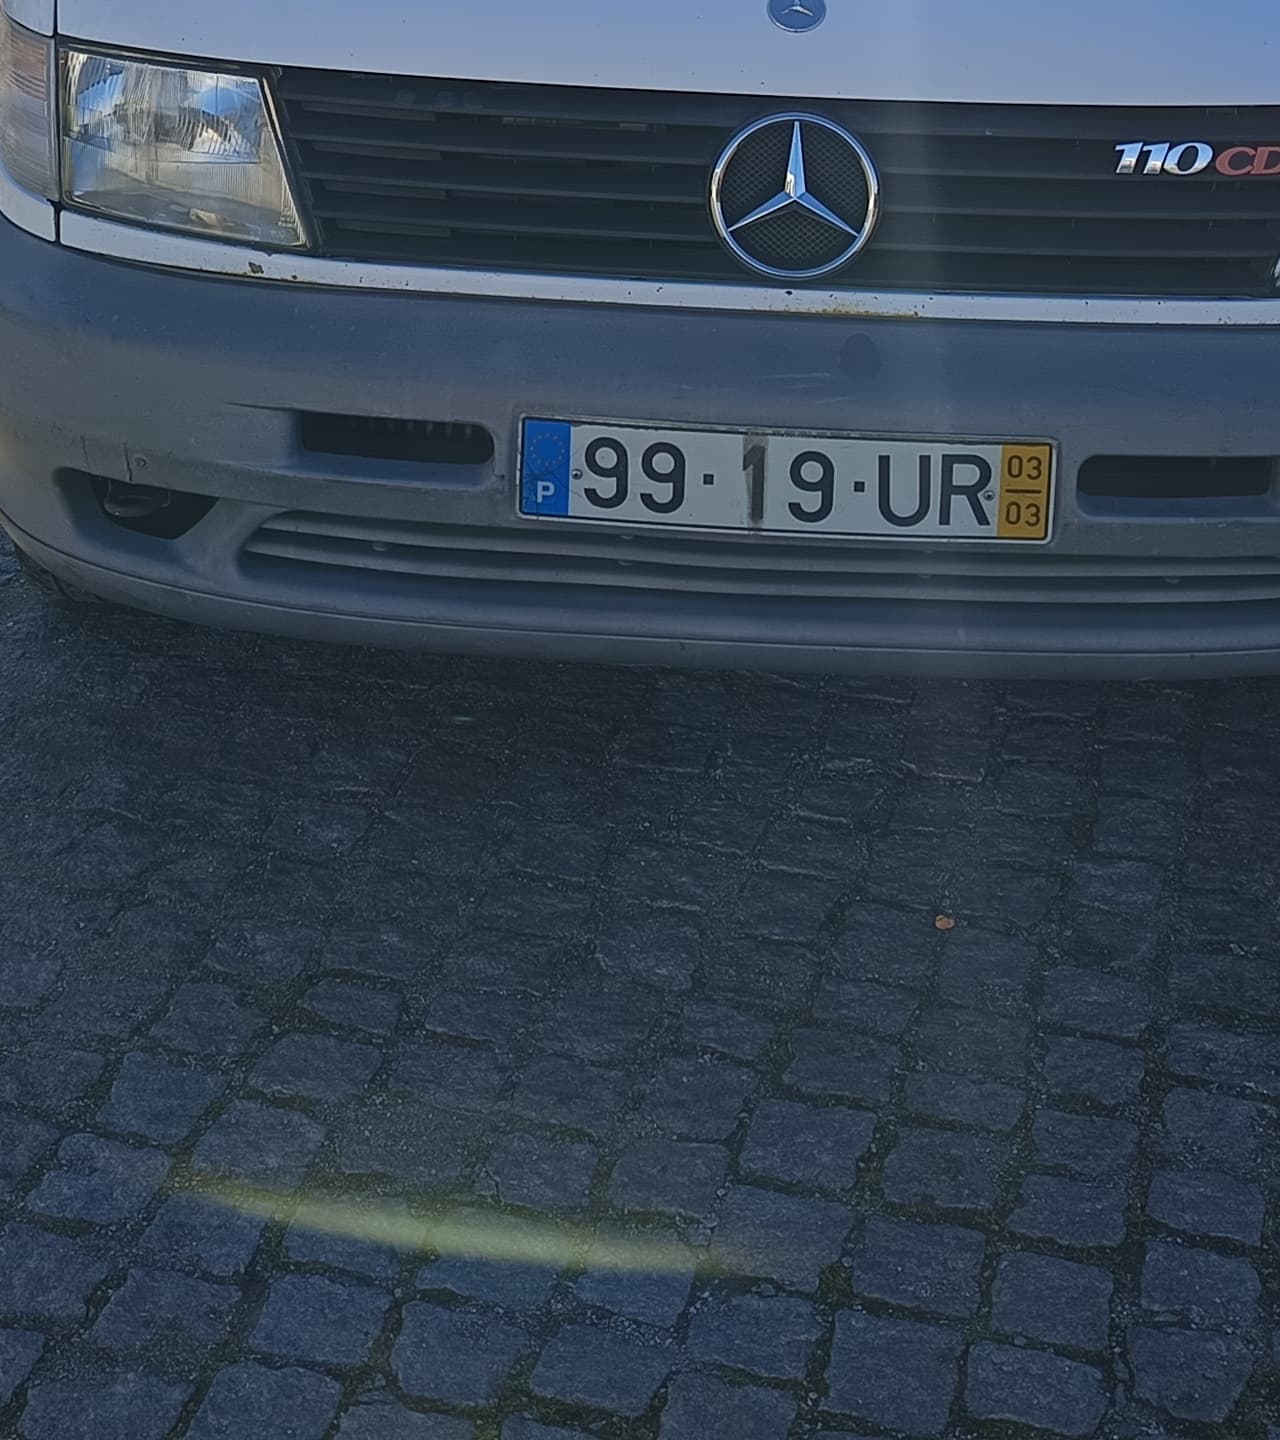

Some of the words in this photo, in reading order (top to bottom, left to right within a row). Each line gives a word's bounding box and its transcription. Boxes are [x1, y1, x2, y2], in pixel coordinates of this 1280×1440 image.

[1007, 454, 1042, 480] 03
[536, 481, 555, 504] P
[1005, 501, 1041, 528] 03
